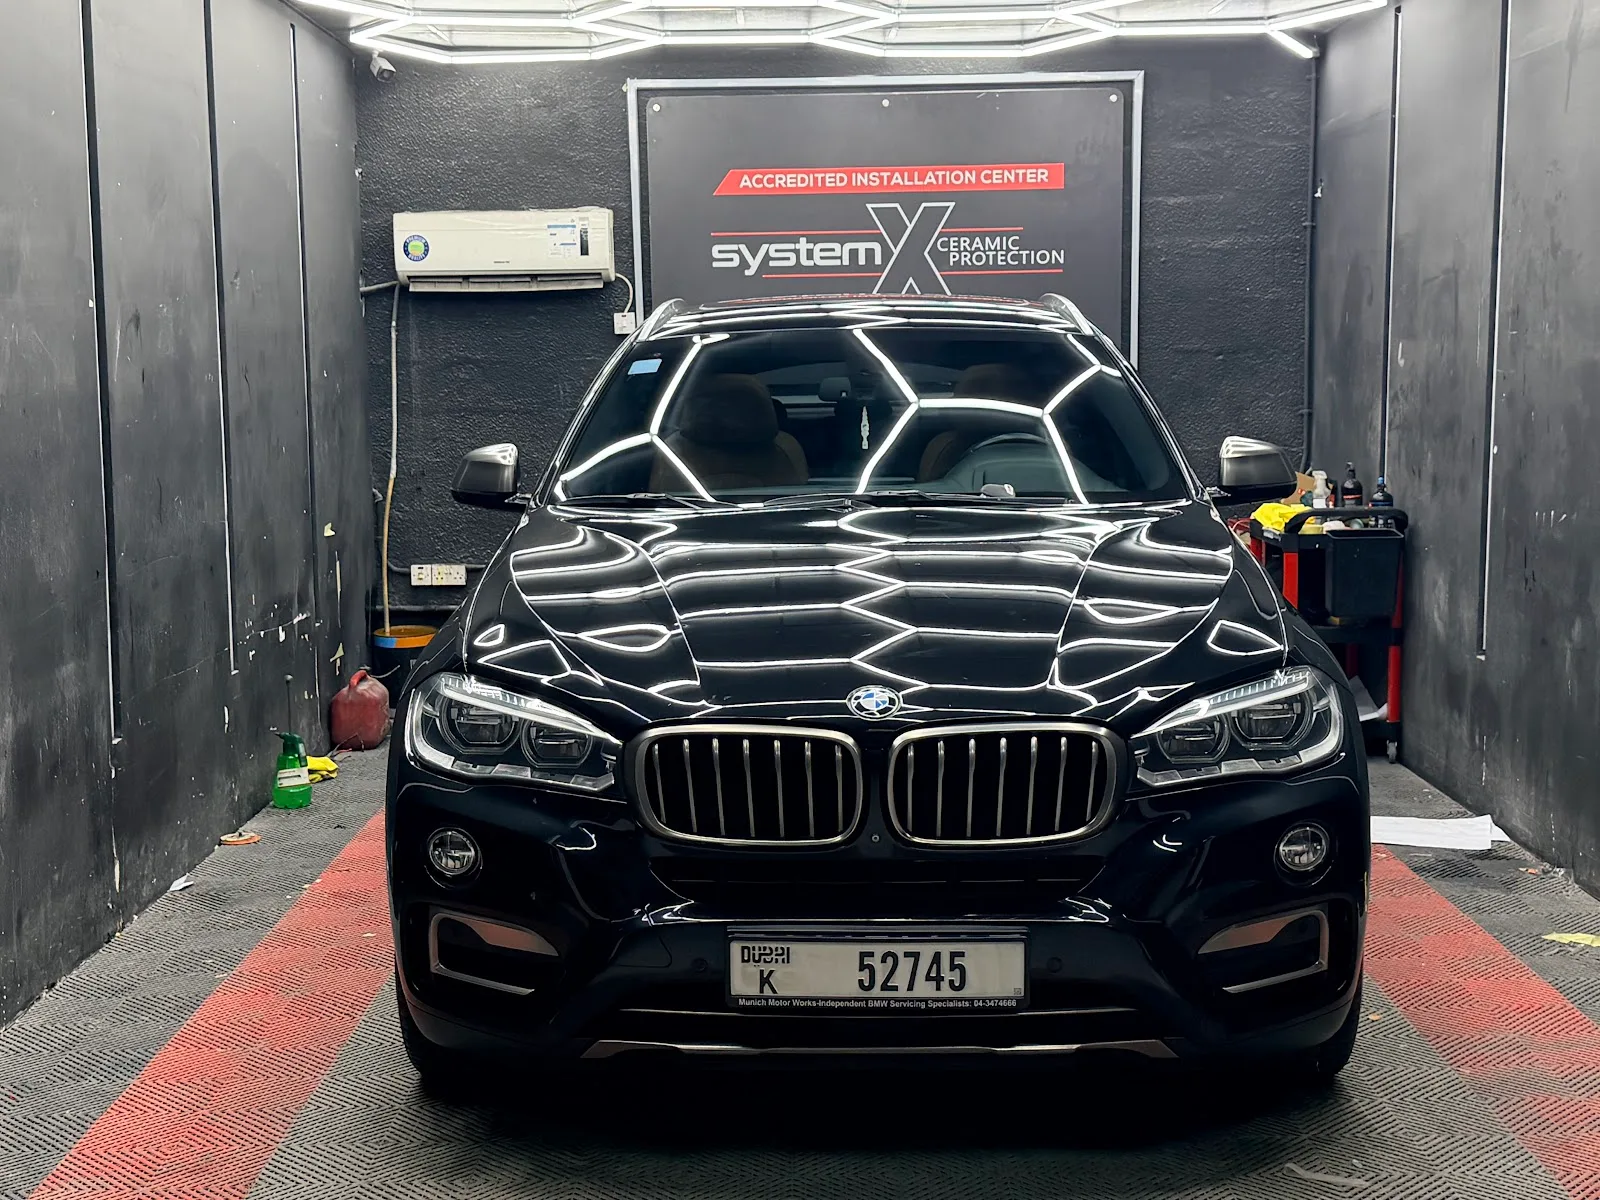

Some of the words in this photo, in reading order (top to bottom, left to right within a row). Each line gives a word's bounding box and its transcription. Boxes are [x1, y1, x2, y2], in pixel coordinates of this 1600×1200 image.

[739, 172, 848, 189] ACCREDITED
[852, 170, 977, 187] INSTALLATION
[980, 168, 1049, 184] CENTER
[936, 236, 1021, 252] CERAMIC
[711, 236, 882, 276] system
[950, 250, 1065, 266] PROTECTION
[741, 945, 790, 964] DUBAI
[857, 951, 967, 991] 52745
[759, 969, 779, 994] K
[738, 998, 767, 1006] Munich
[792, 999, 867, 1008] Works-Independent
[889, 1000, 926, 1009] Servicing
[927, 1000, 972, 1009] Specialists:
